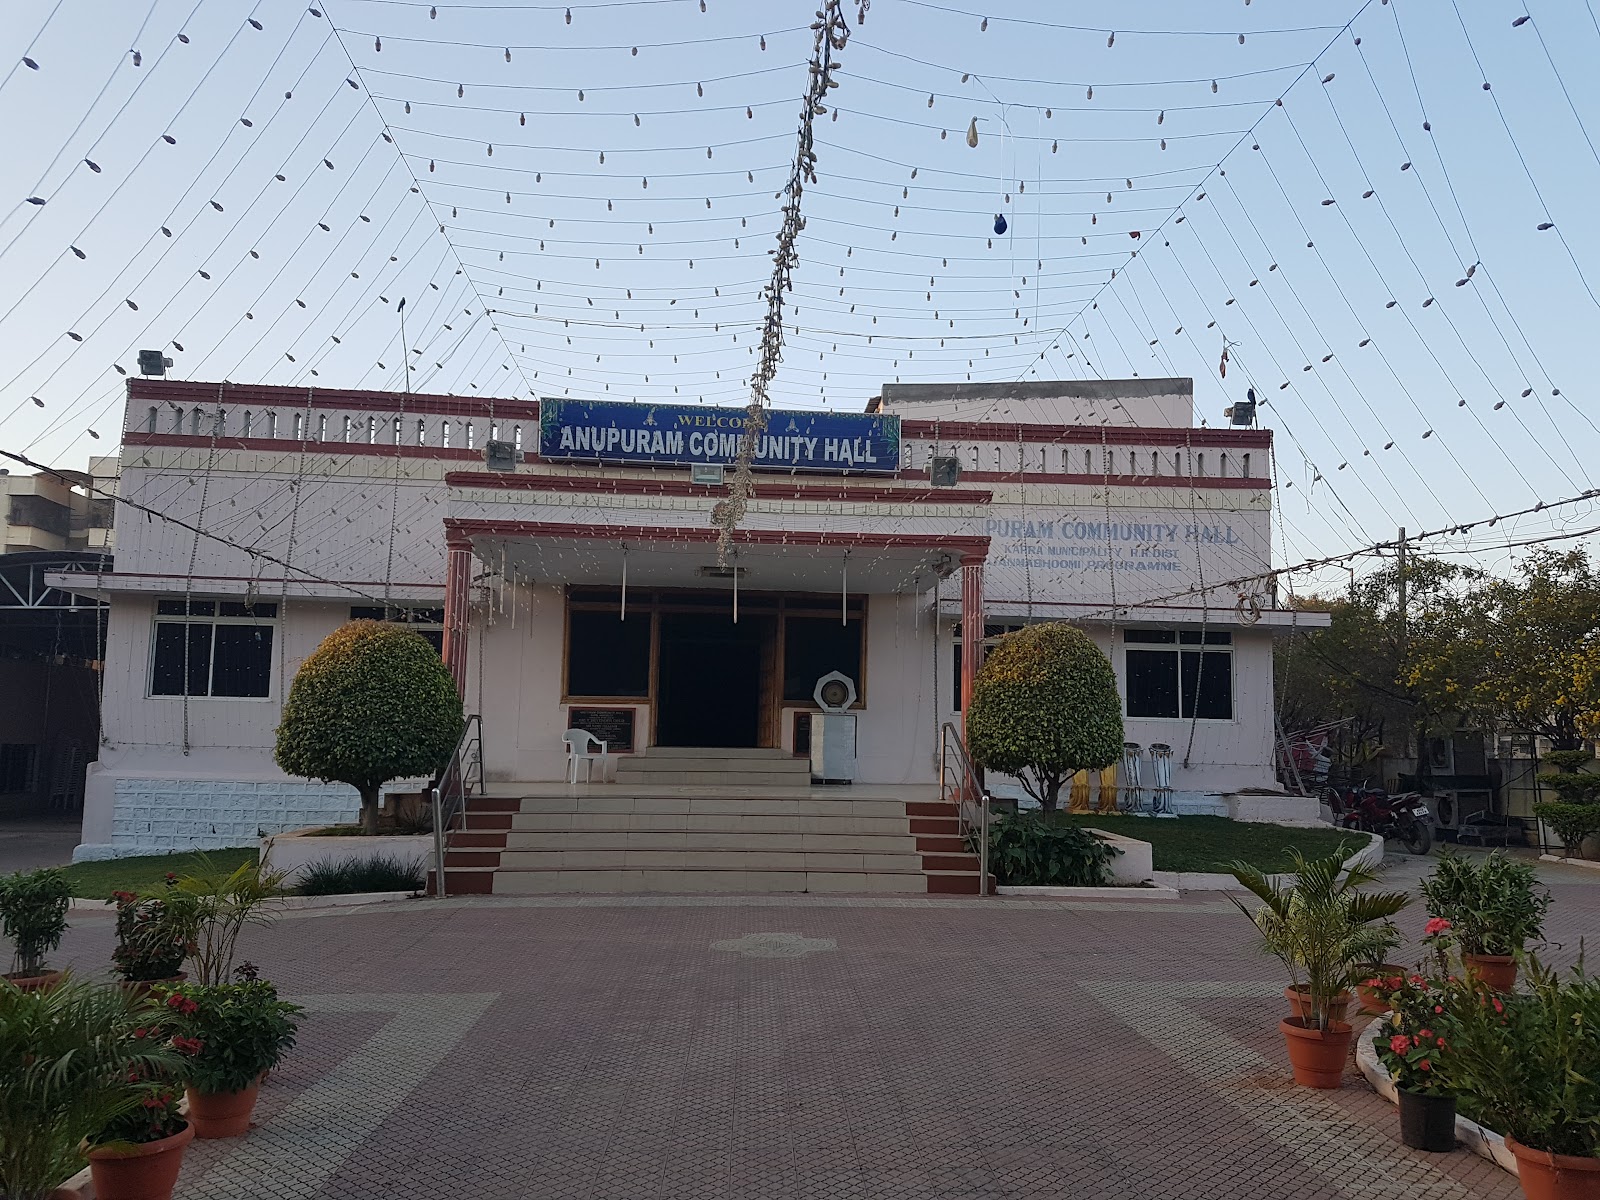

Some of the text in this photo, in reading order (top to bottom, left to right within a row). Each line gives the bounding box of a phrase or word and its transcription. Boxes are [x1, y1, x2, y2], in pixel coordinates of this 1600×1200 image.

[677, 414, 763, 430] WELCO
[559, 425, 683, 455] ANUPURAM
[823, 437, 877, 464] HALL
[1062, 522, 1177, 543] COMMUNITY
[1184, 523, 1239, 545] HALL
[1004, 545, 1043, 555] KAPRA
